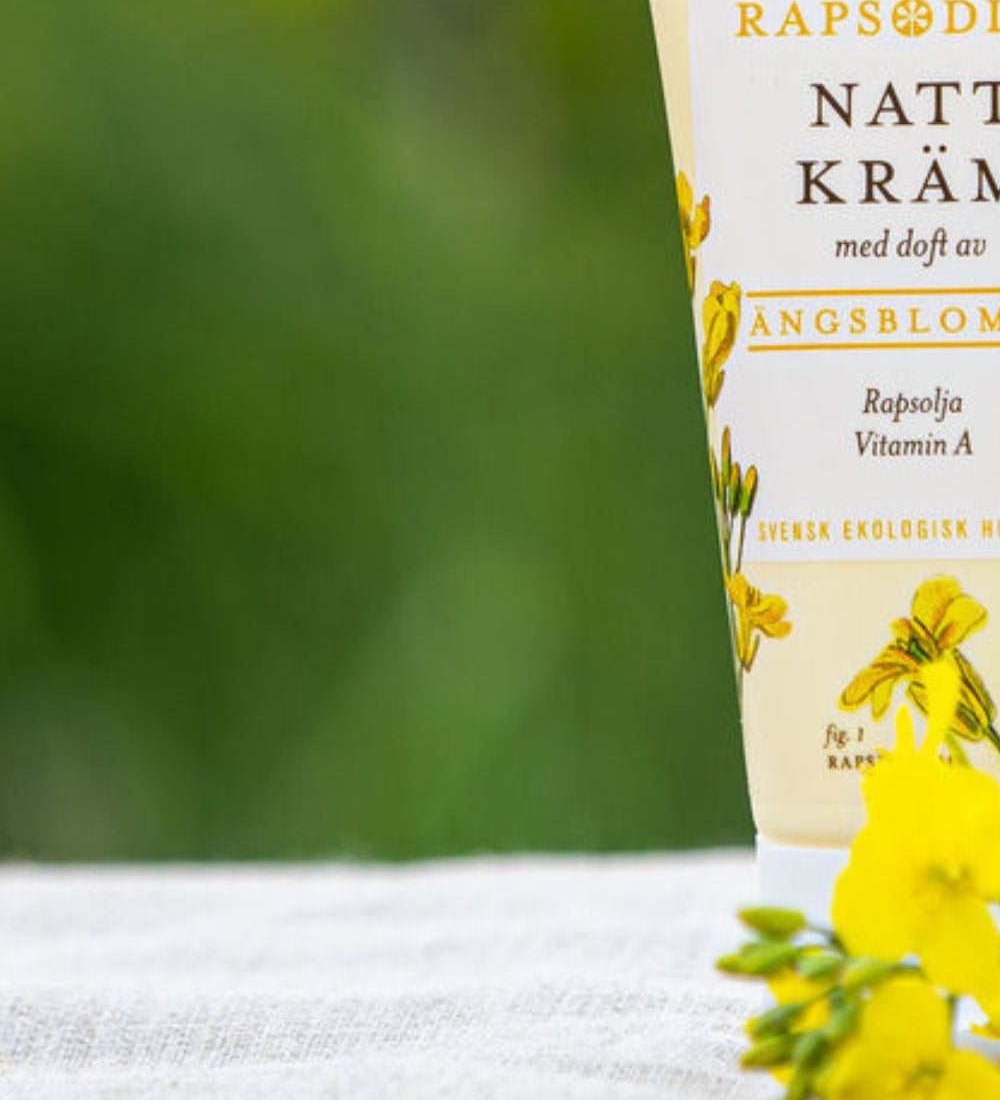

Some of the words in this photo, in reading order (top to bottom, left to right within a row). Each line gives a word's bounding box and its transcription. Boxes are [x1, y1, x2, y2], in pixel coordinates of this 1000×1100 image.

[834, 228, 890, 259] med
[896, 228, 948, 268] doft
[955, 238, 987, 258] av
[863, 387, 963, 421] Rapsolja
[855, 431, 947, 457] Vitamin
[952, 431, 973, 456] A
[757, 520, 830, 542] SVENSK
[842, 518, 968, 541] EKOLOGISK
[823, 723, 850, 749] fig.
